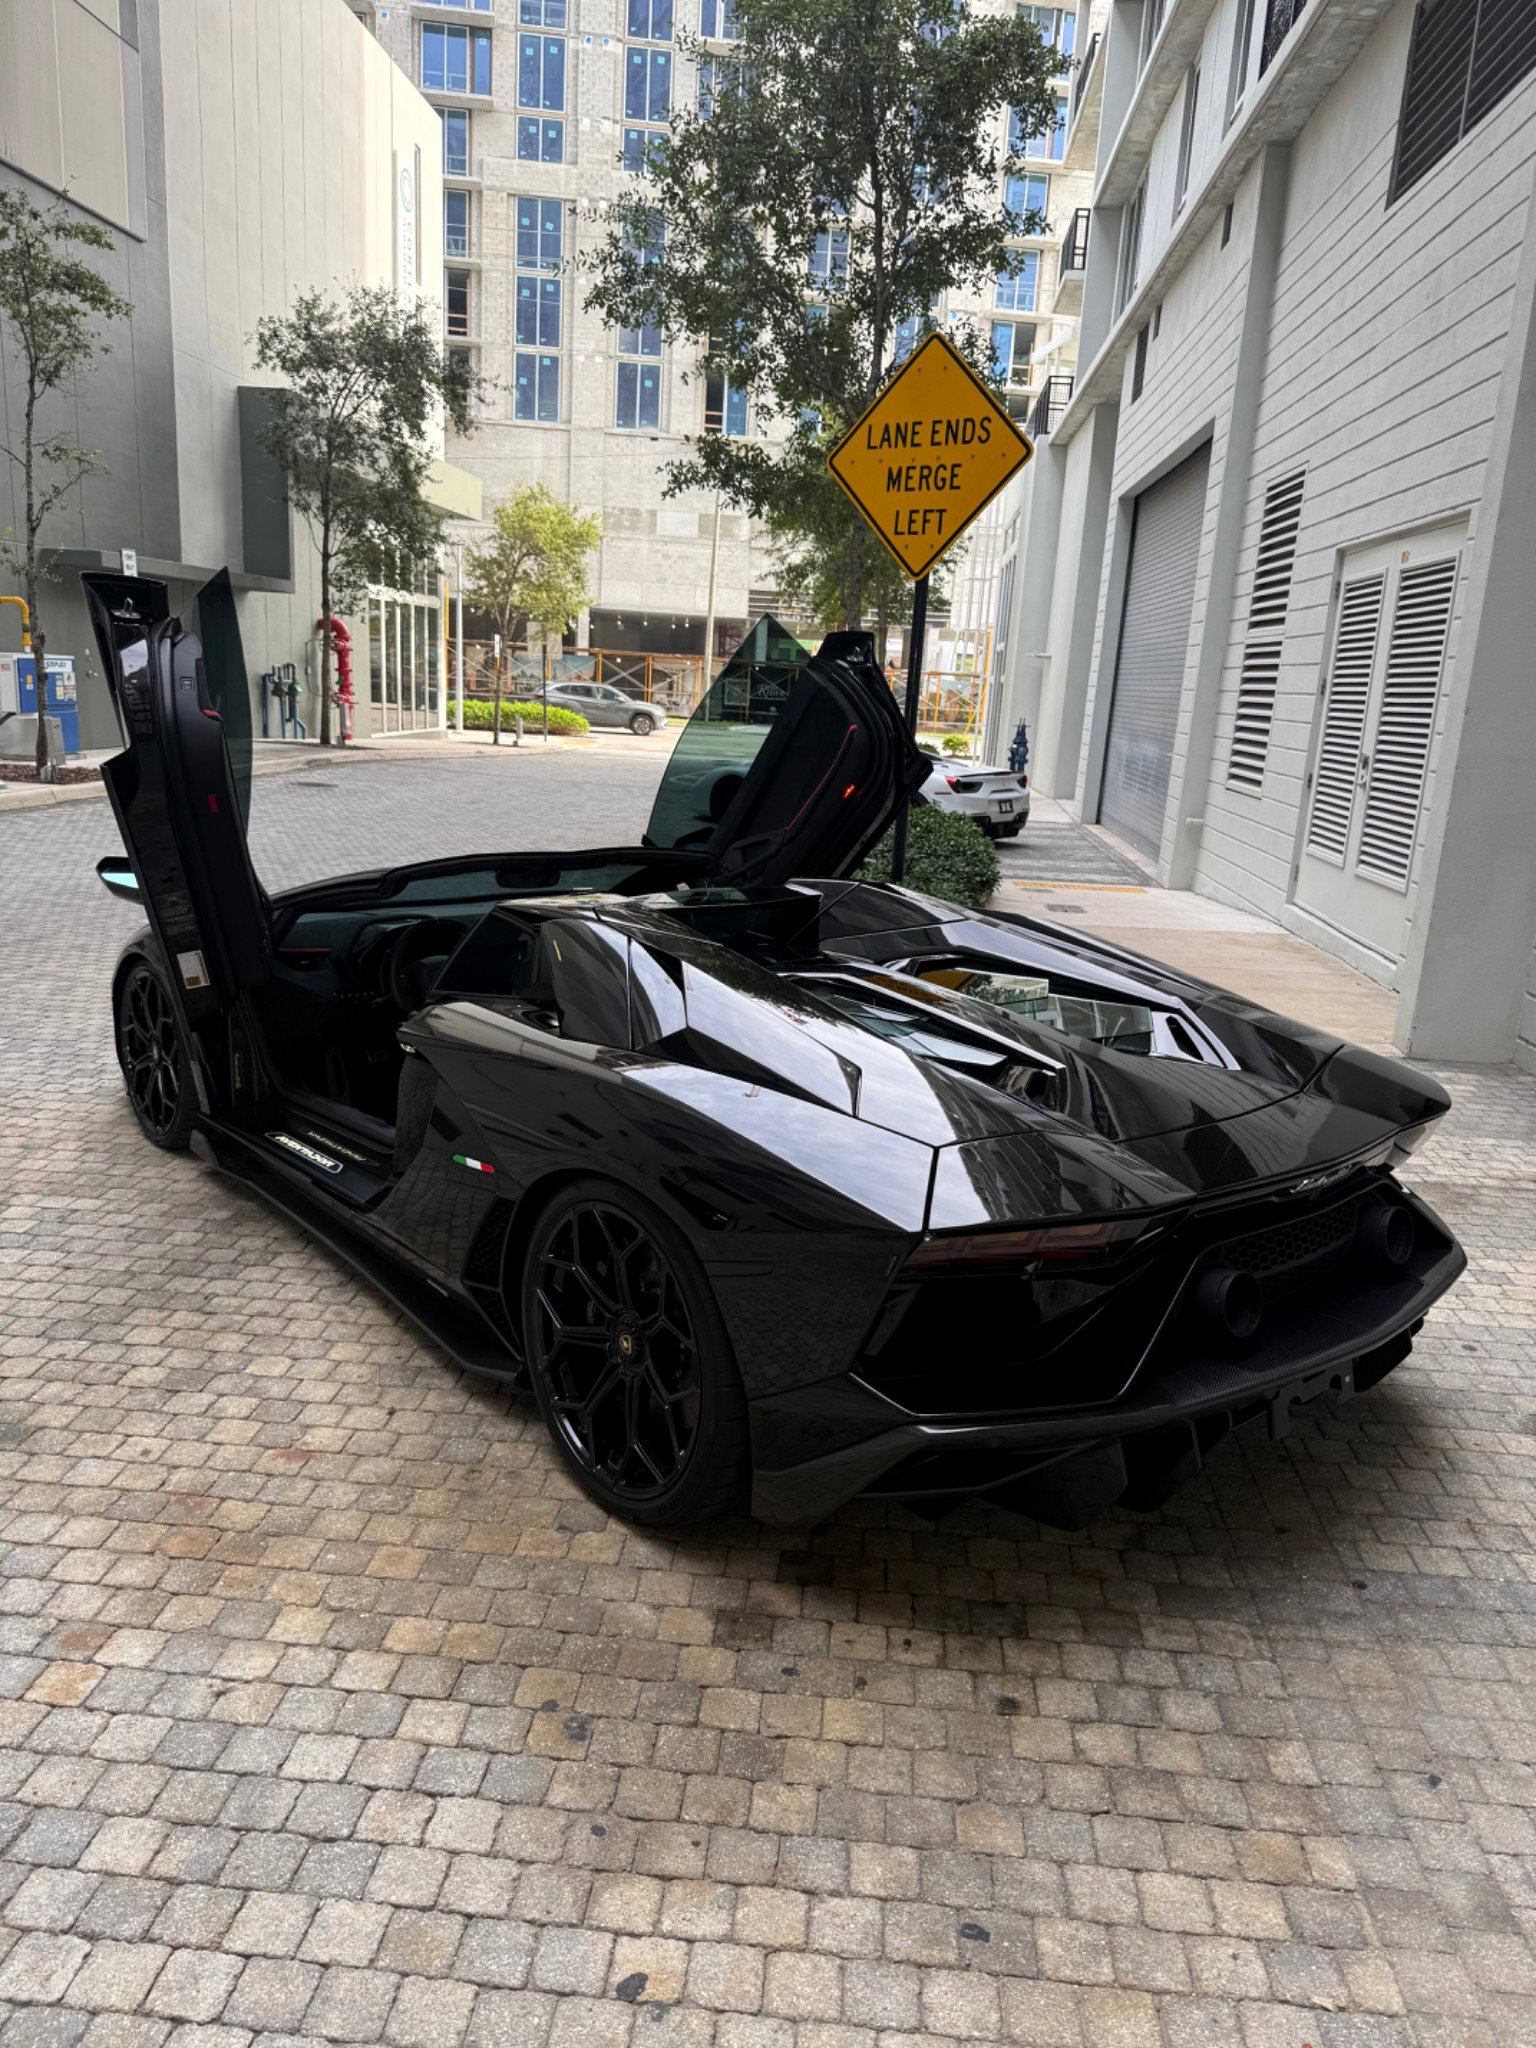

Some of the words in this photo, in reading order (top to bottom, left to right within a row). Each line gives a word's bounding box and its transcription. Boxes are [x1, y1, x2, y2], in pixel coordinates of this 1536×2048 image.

[867, 421, 923, 450] LANE
[930, 416, 992, 447] ENDS
[886, 463, 962, 493] MERGE
[894, 508, 947, 536] LEFT
